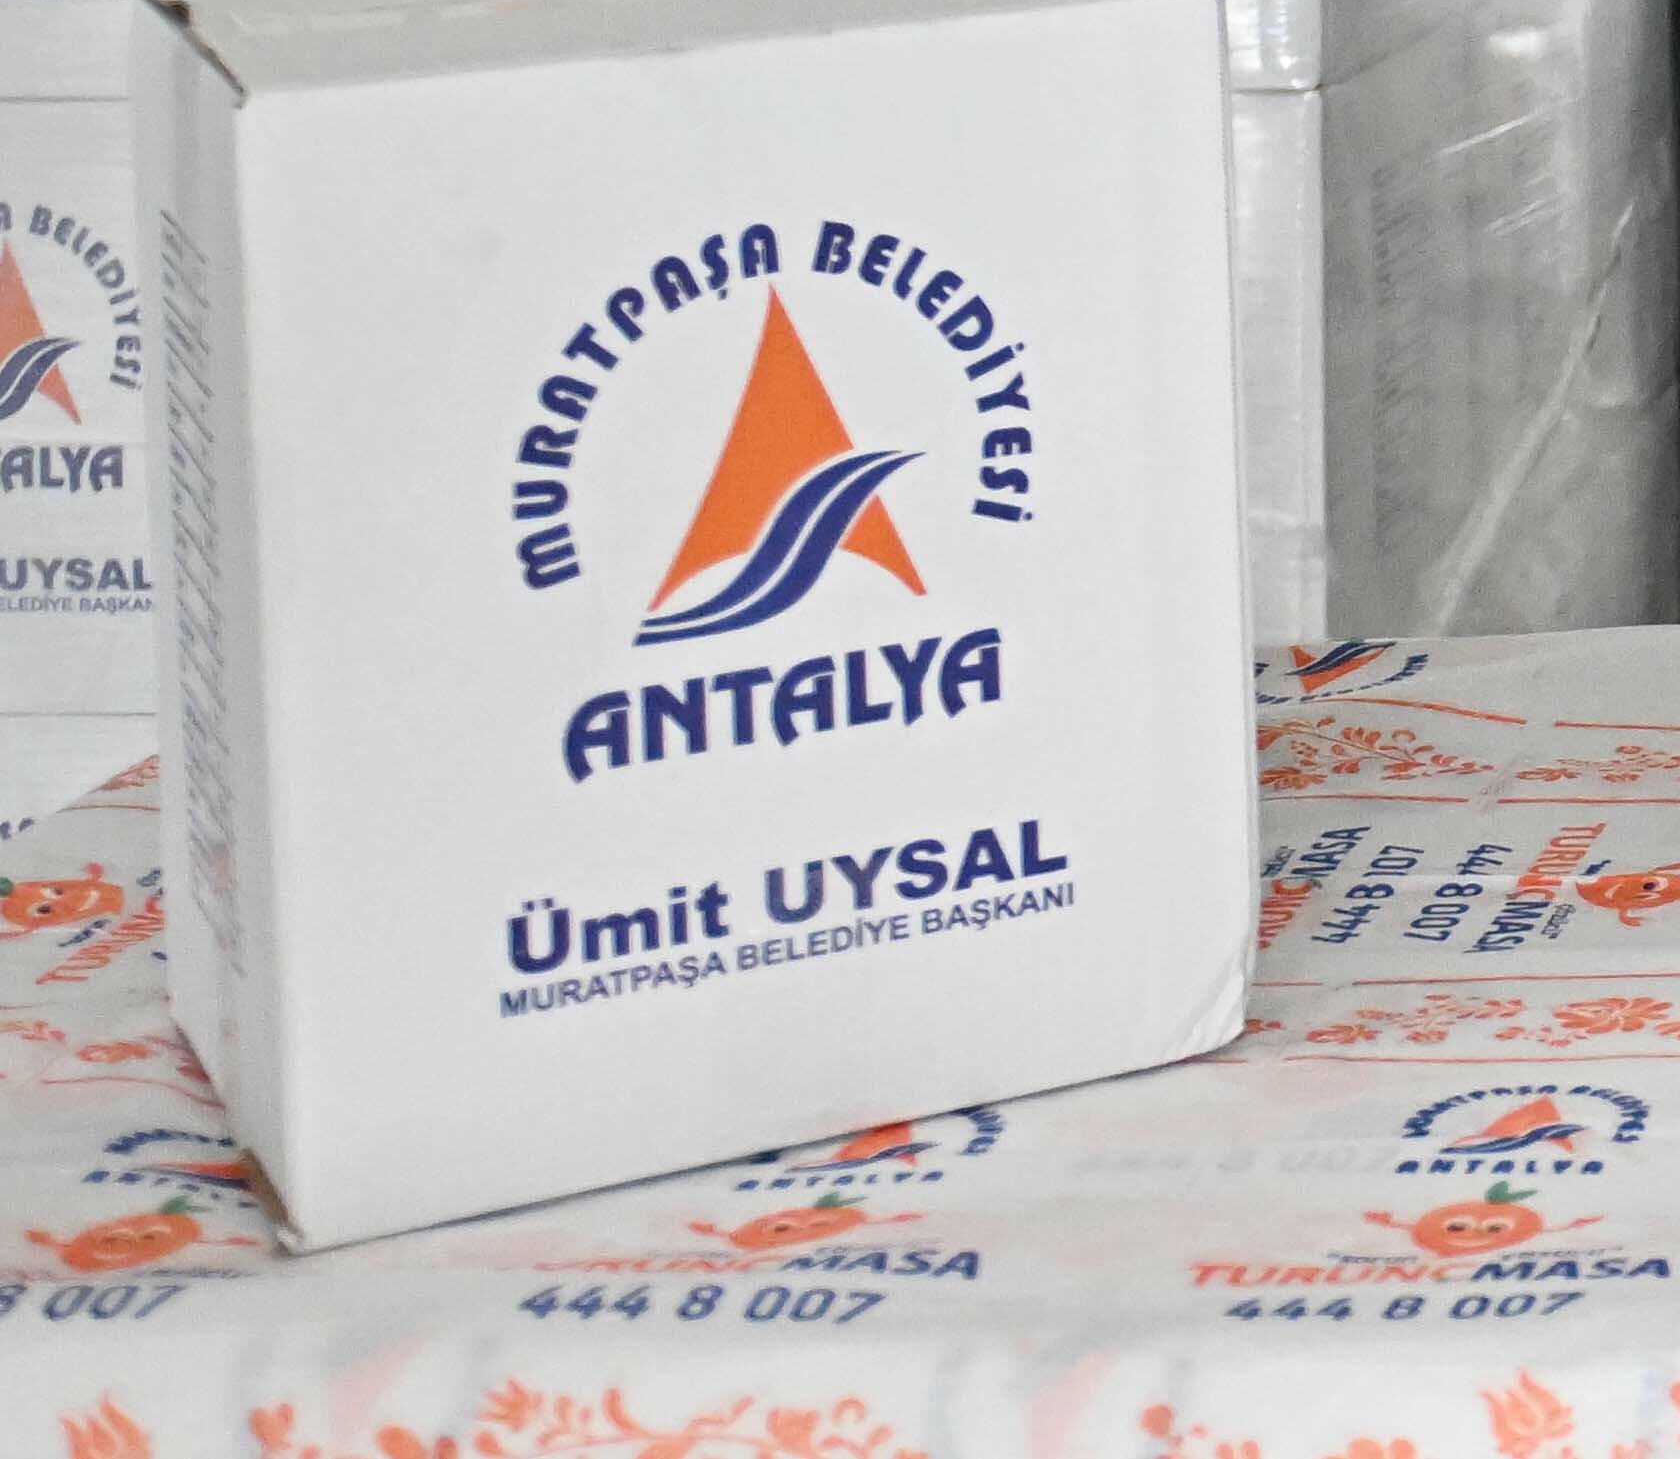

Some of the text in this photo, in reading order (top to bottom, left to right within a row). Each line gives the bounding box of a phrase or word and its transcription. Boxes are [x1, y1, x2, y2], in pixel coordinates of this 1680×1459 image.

[511, 222, 780, 591] MURATPAŞA
[810, 220, 1036, 525] BELEDİYESİ
[562, 625, 1003, 784] ANTALYA
[499, 881, 1076, 1017] MURATPAŞA BELEDİYE BAŞKANI
[506, 818, 1069, 973] Ümit UYSAL
[43, 1284, 187, 1321] 007
[518, 1284, 887, 1321] 444 8 007
[1223, 1289, 1587, 1323] 444 8 007
